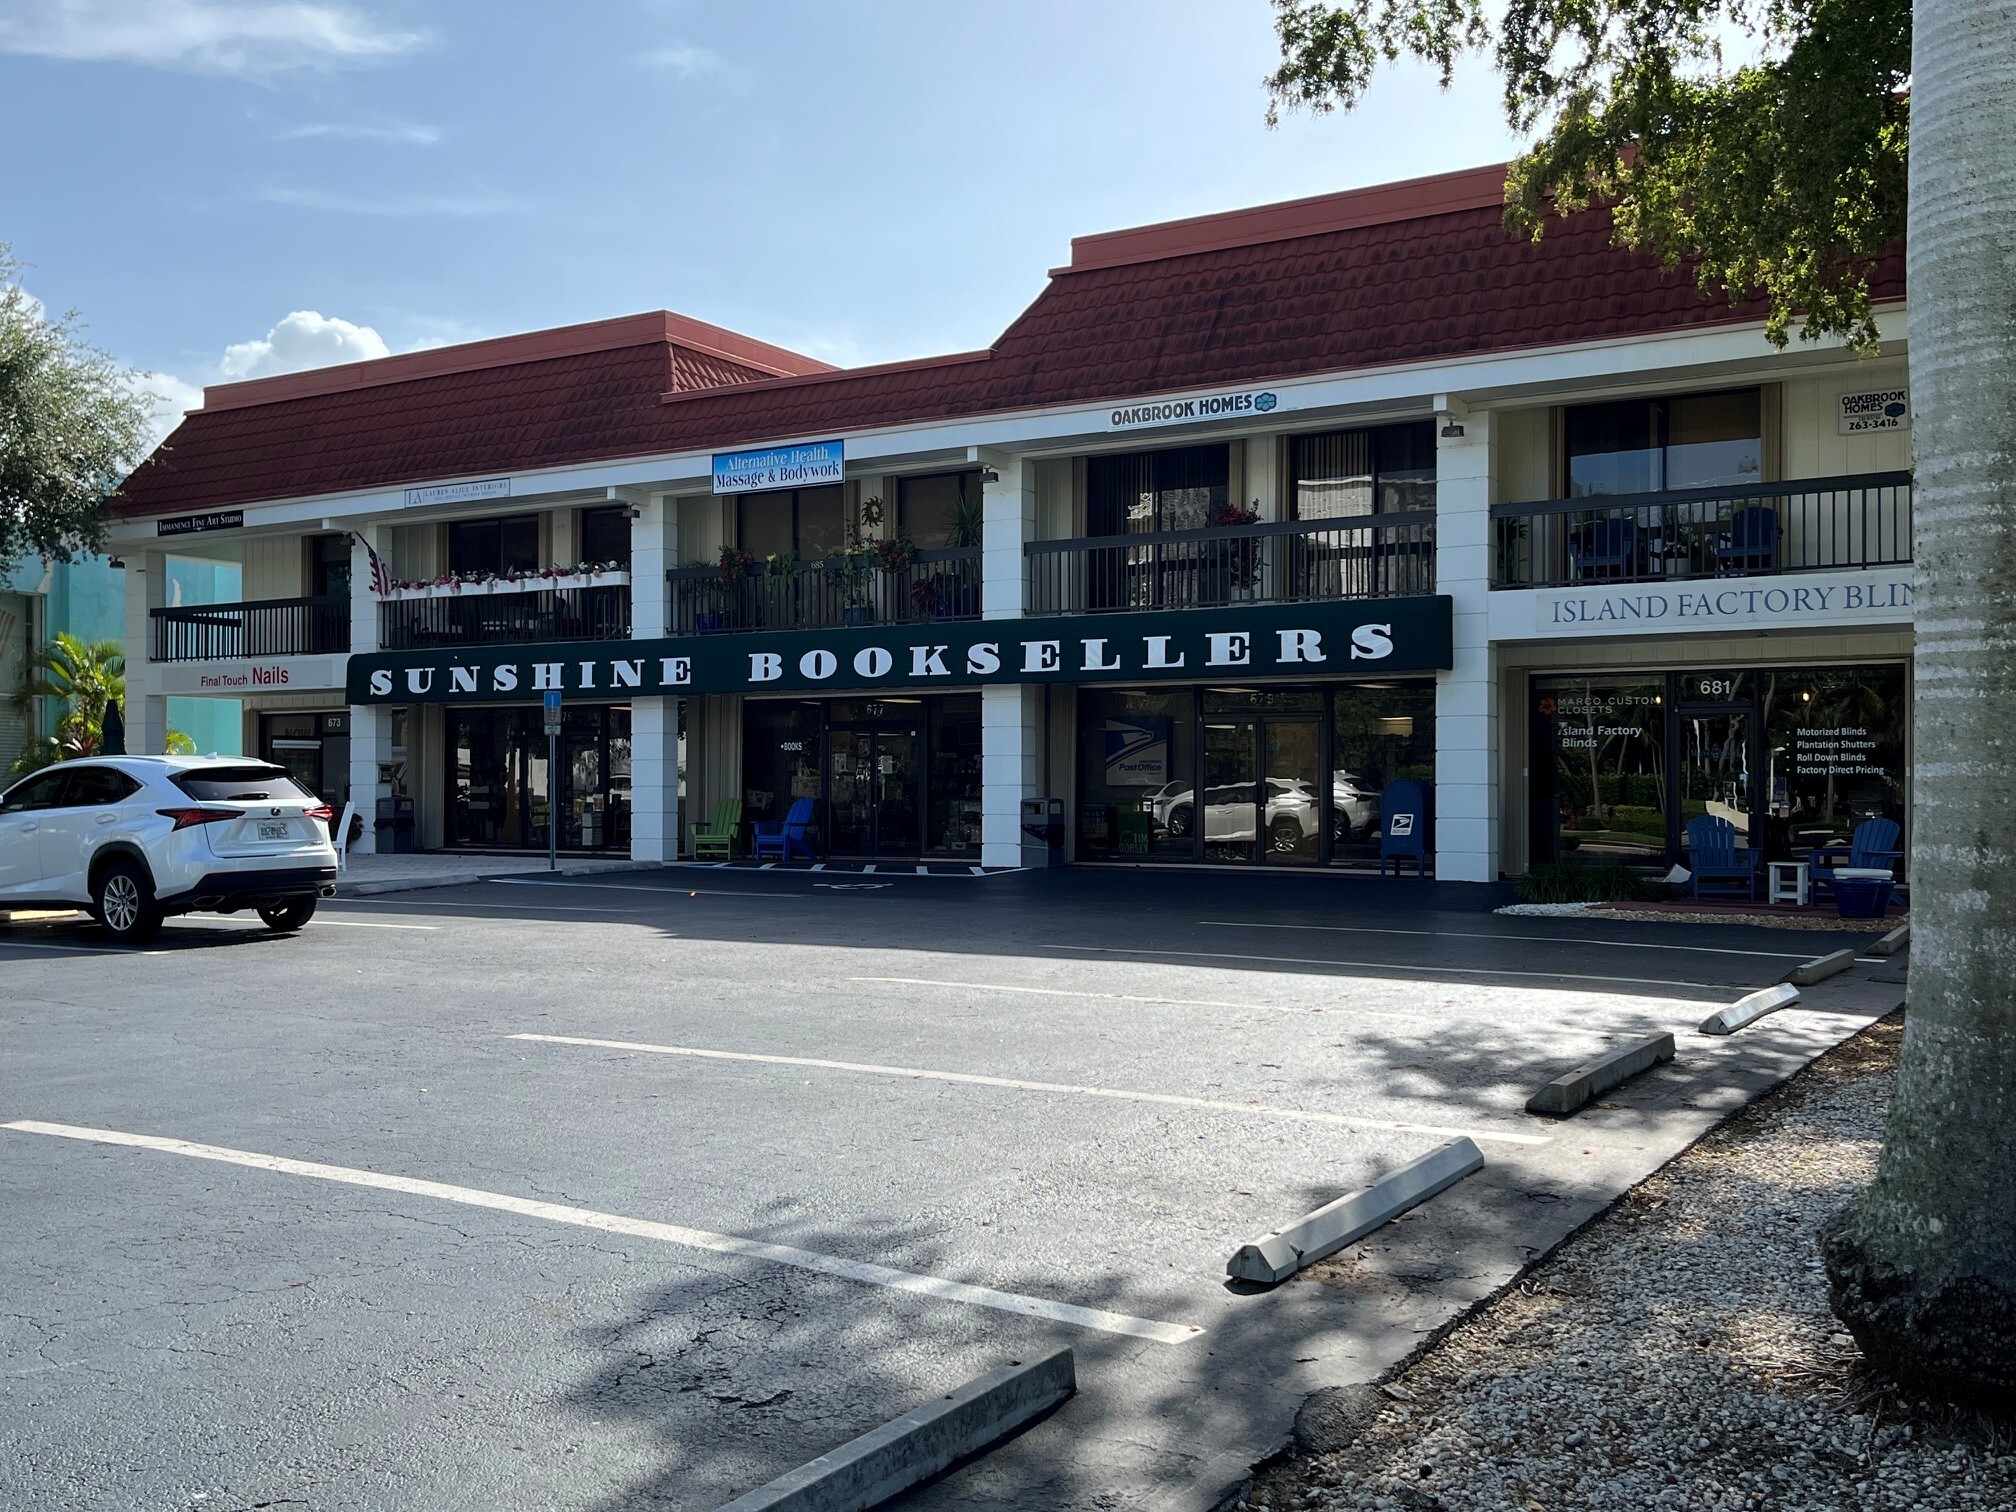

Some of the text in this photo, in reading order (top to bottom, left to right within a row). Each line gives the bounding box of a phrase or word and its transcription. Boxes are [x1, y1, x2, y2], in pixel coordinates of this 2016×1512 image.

[1842, 391, 1906, 406] OAKBROOK
[1111, 393, 1252, 427] OAKBROOK HOMES
[1844, 402, 1883, 414] HOMES
[1848, 418, 1898, 430] 263-3416
[726, 446, 828, 471] Alternative Health
[716, 460, 840, 488] Massage & Bodywork
[425, 481, 508, 498] LAUREN ALICE INTERIORS
[206, 515, 219, 526] ART
[220, 513, 242, 524] STUDIO
[811, 560, 824, 569] 685
[1553, 593, 1668, 624] ISLAND
[1676, 586, 1836, 618] FACTORY
[369, 622, 1395, 697] SUNSHINE BOOKSELLERS
[201, 666, 289, 687] Final Touch Nails
[1700, 680, 1731, 695] 681
[1250, 693, 1274, 704] 679
[1557, 697, 1601, 706] MARCO
[866, 704, 884, 715] 677
[1557, 706, 1613, 715] CLOSETS
[562, 711, 573, 722] 75
[328, 718, 341, 728] 673
[1558, 722, 1642, 738] Island Factory
[1797, 727, 1867, 736] Motorized Blinds
[784, 742, 803, 751] BOOKS
[1562, 738, 1598, 748] Blinds
[1797, 740, 1876, 749] Plantation Shutters
[1797, 753, 1866, 762] Roll Down Blinds
[1119, 763, 1162, 771] Post Office
[1797, 765, 1885, 776] Factory Direct Pricing
[1133, 833, 1149, 843] TIM
